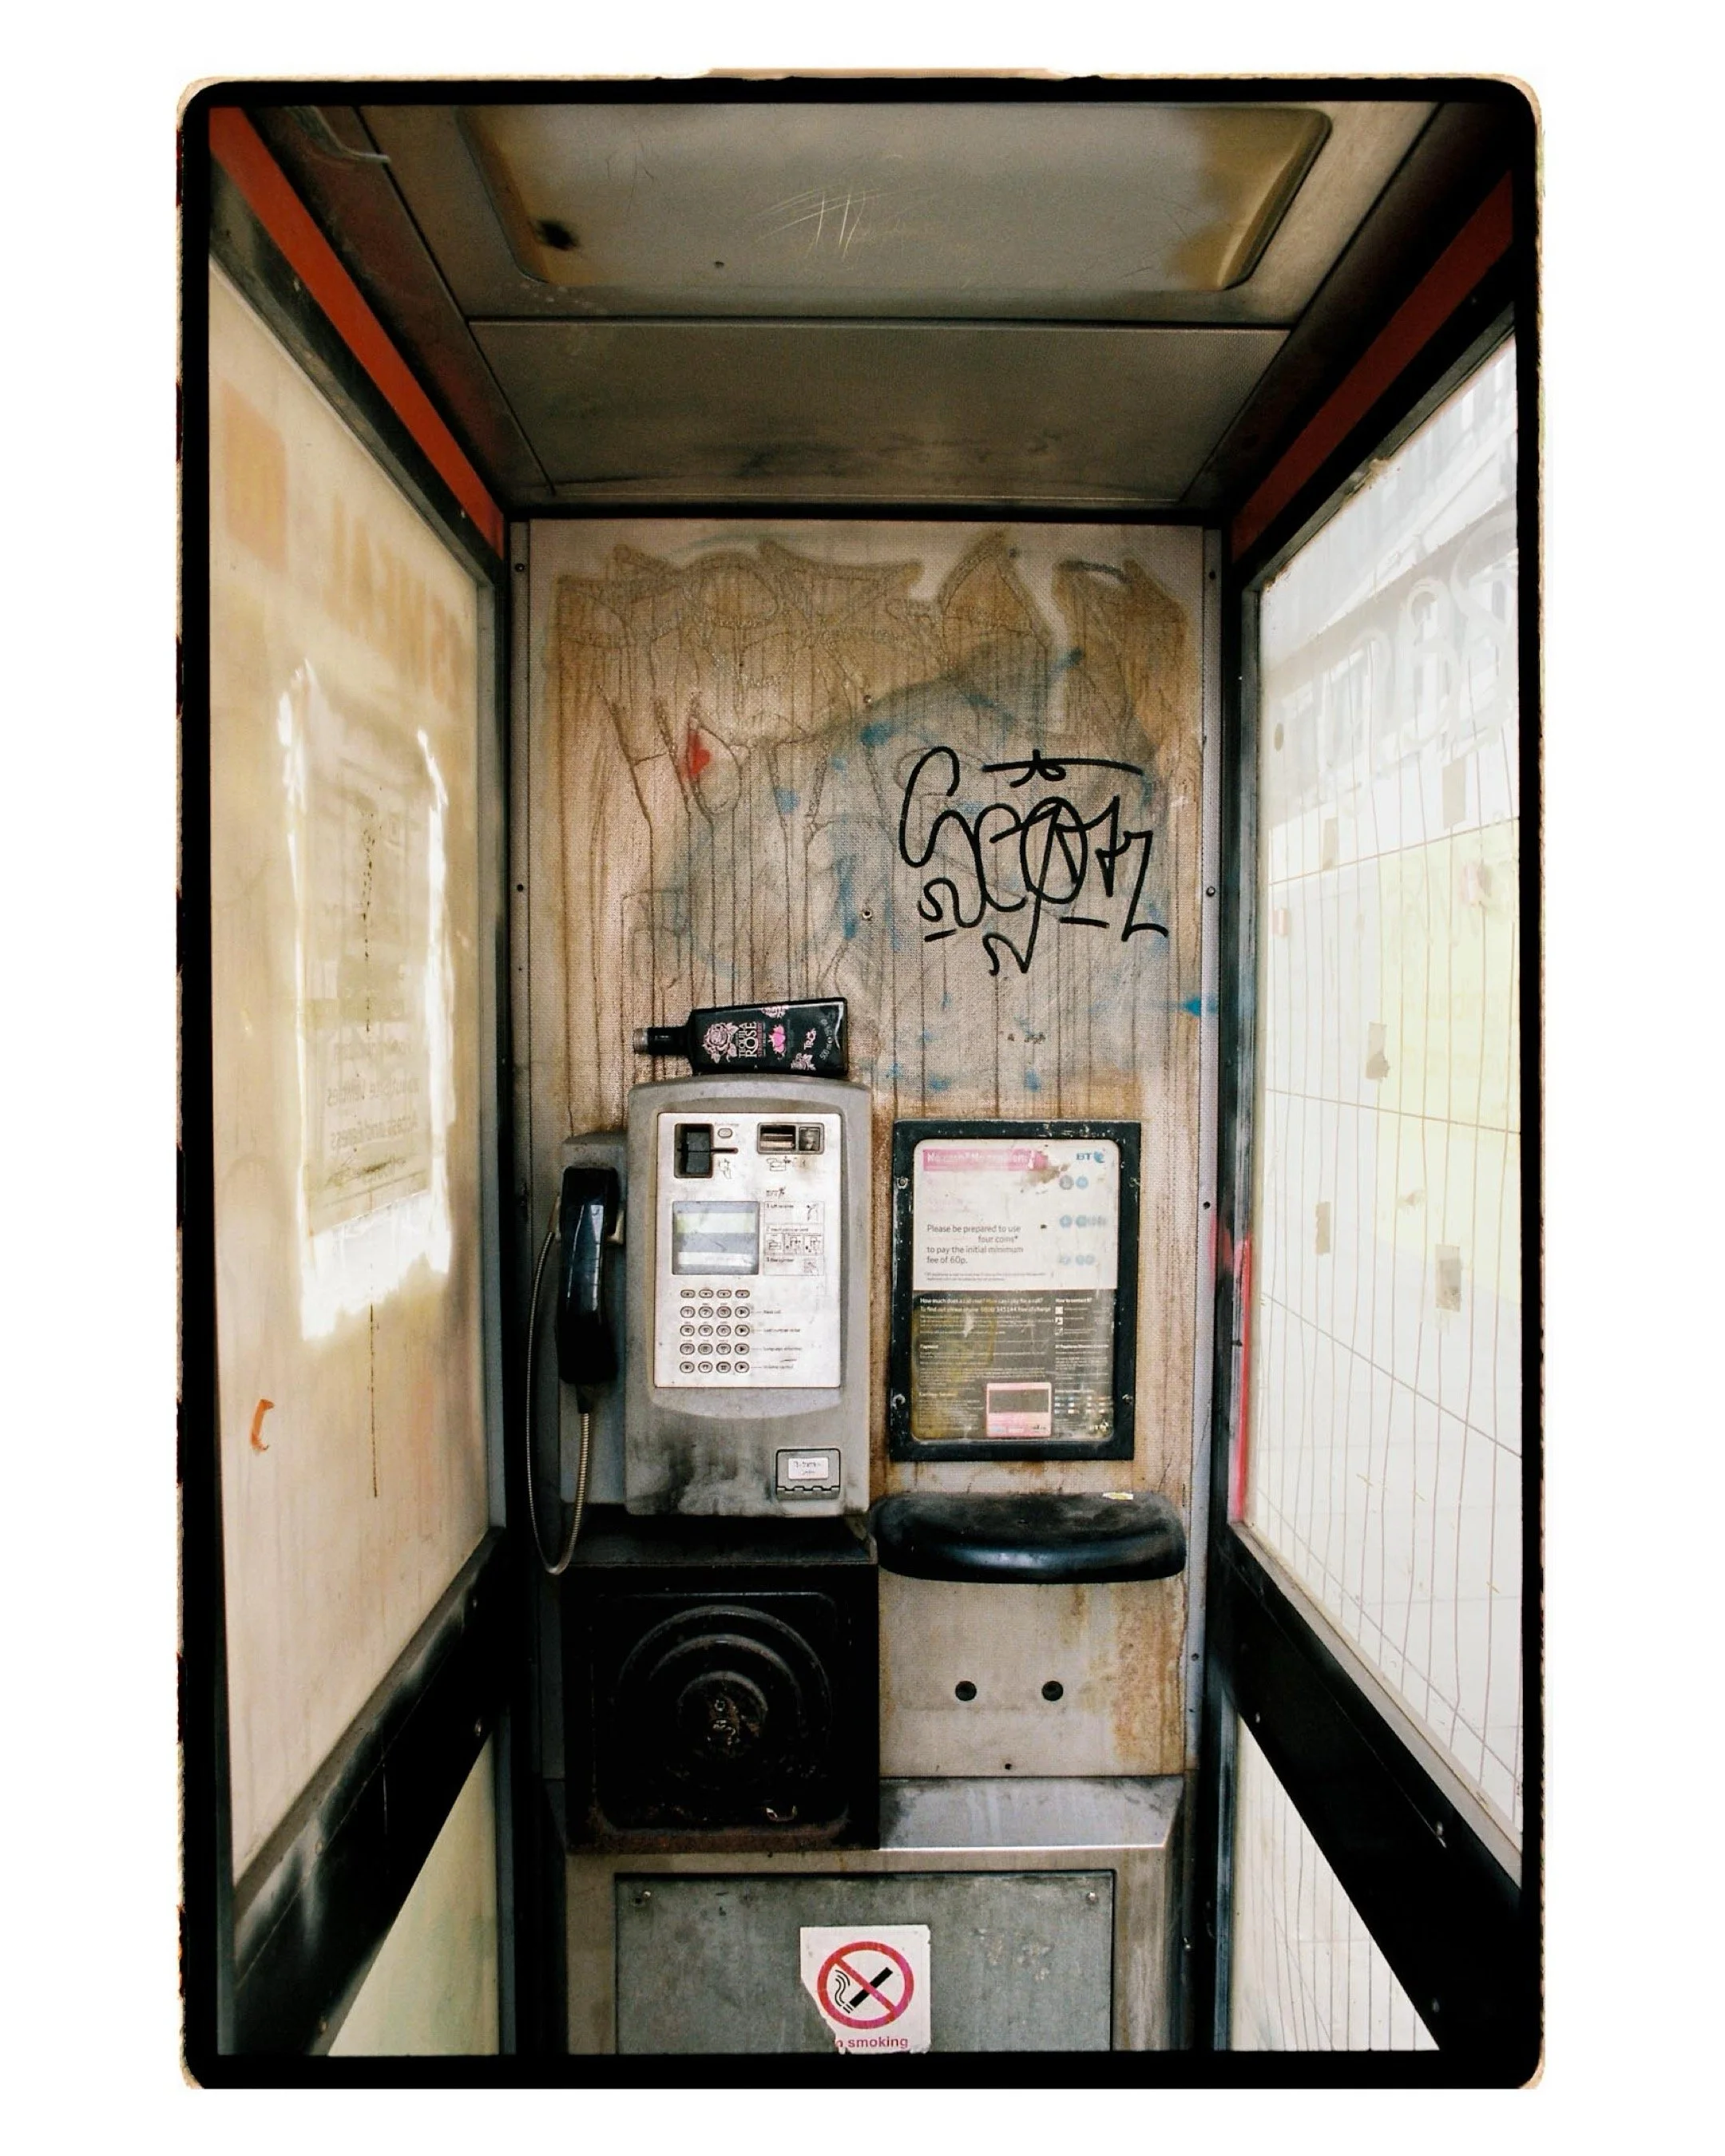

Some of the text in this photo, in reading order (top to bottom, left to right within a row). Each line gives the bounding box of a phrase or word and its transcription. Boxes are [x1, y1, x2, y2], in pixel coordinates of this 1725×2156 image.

[738, 1022, 747, 1059] TEQUILA
[745, 1021, 759, 1058] ROSE
[926, 1224, 951, 1233] Please
[952, 1224, 962, 1233] be
[963, 1224, 997, 1234] prepared
[978, 1235, 993, 1243] four
[926, 1255, 968, 1265] fee of 60p.
[847, 2037, 909, 2048] smoking
